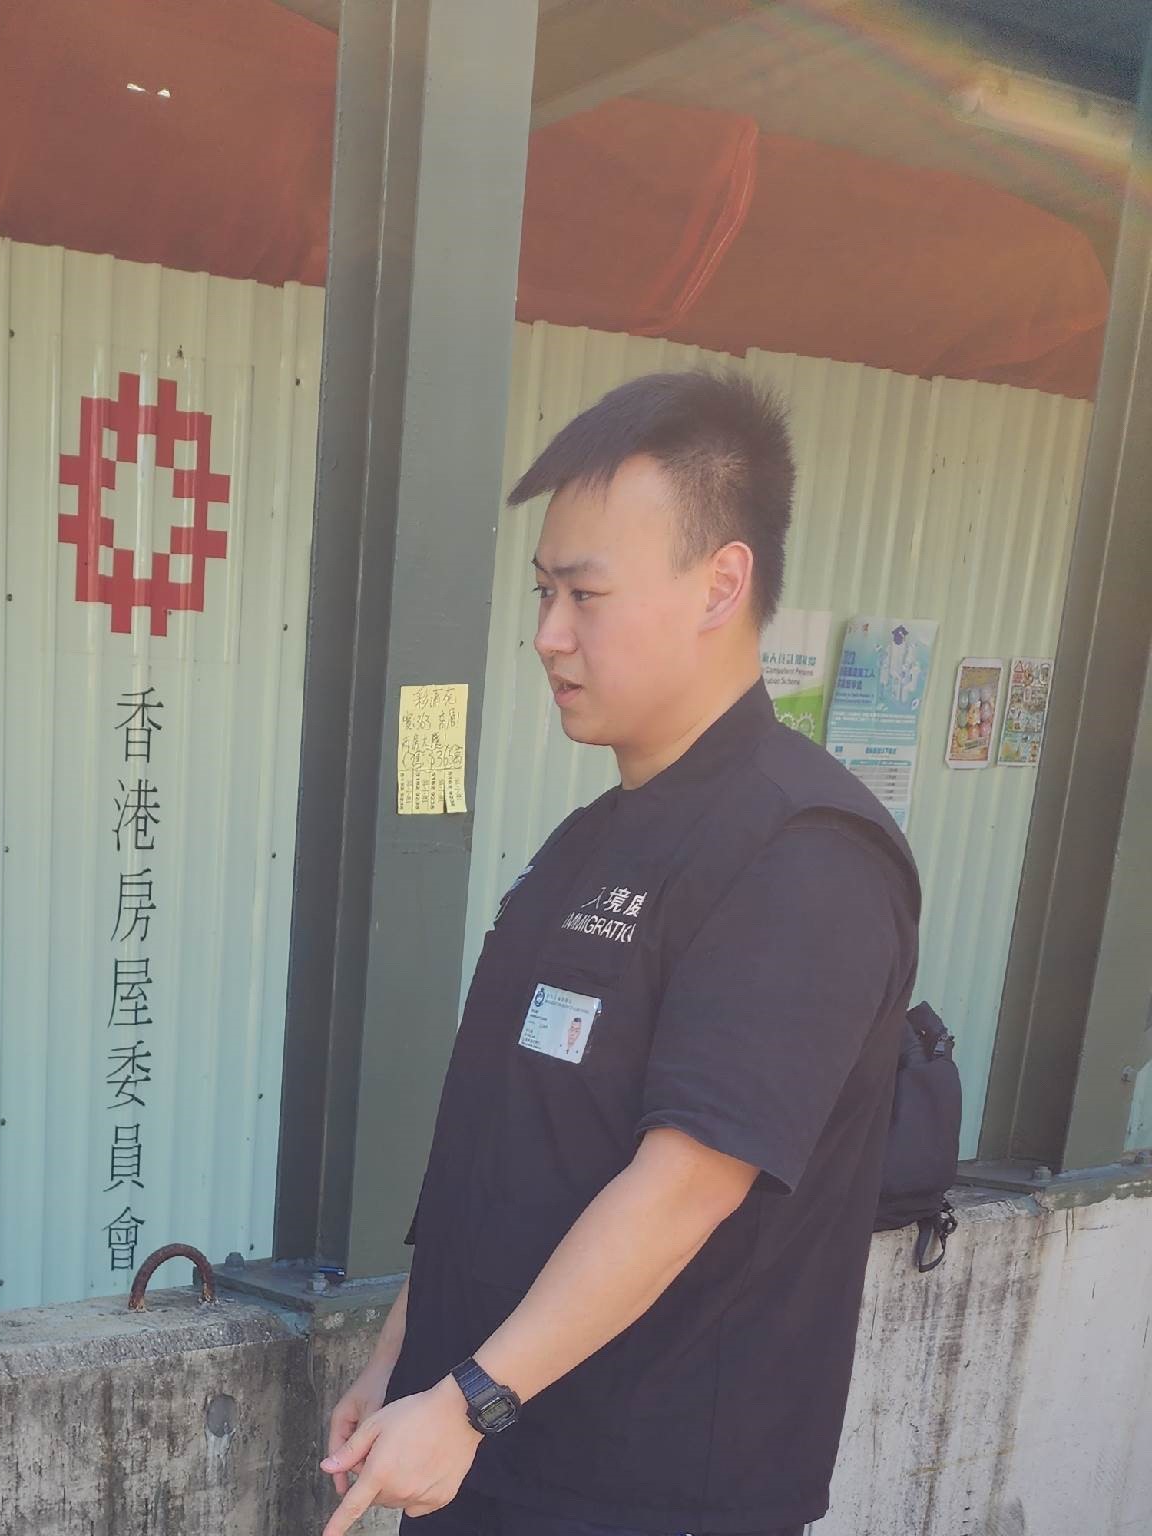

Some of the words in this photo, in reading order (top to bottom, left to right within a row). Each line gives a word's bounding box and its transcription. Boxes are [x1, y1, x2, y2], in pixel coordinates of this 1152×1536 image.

[102, 686, 165, 1272] 香港房屋委員會
